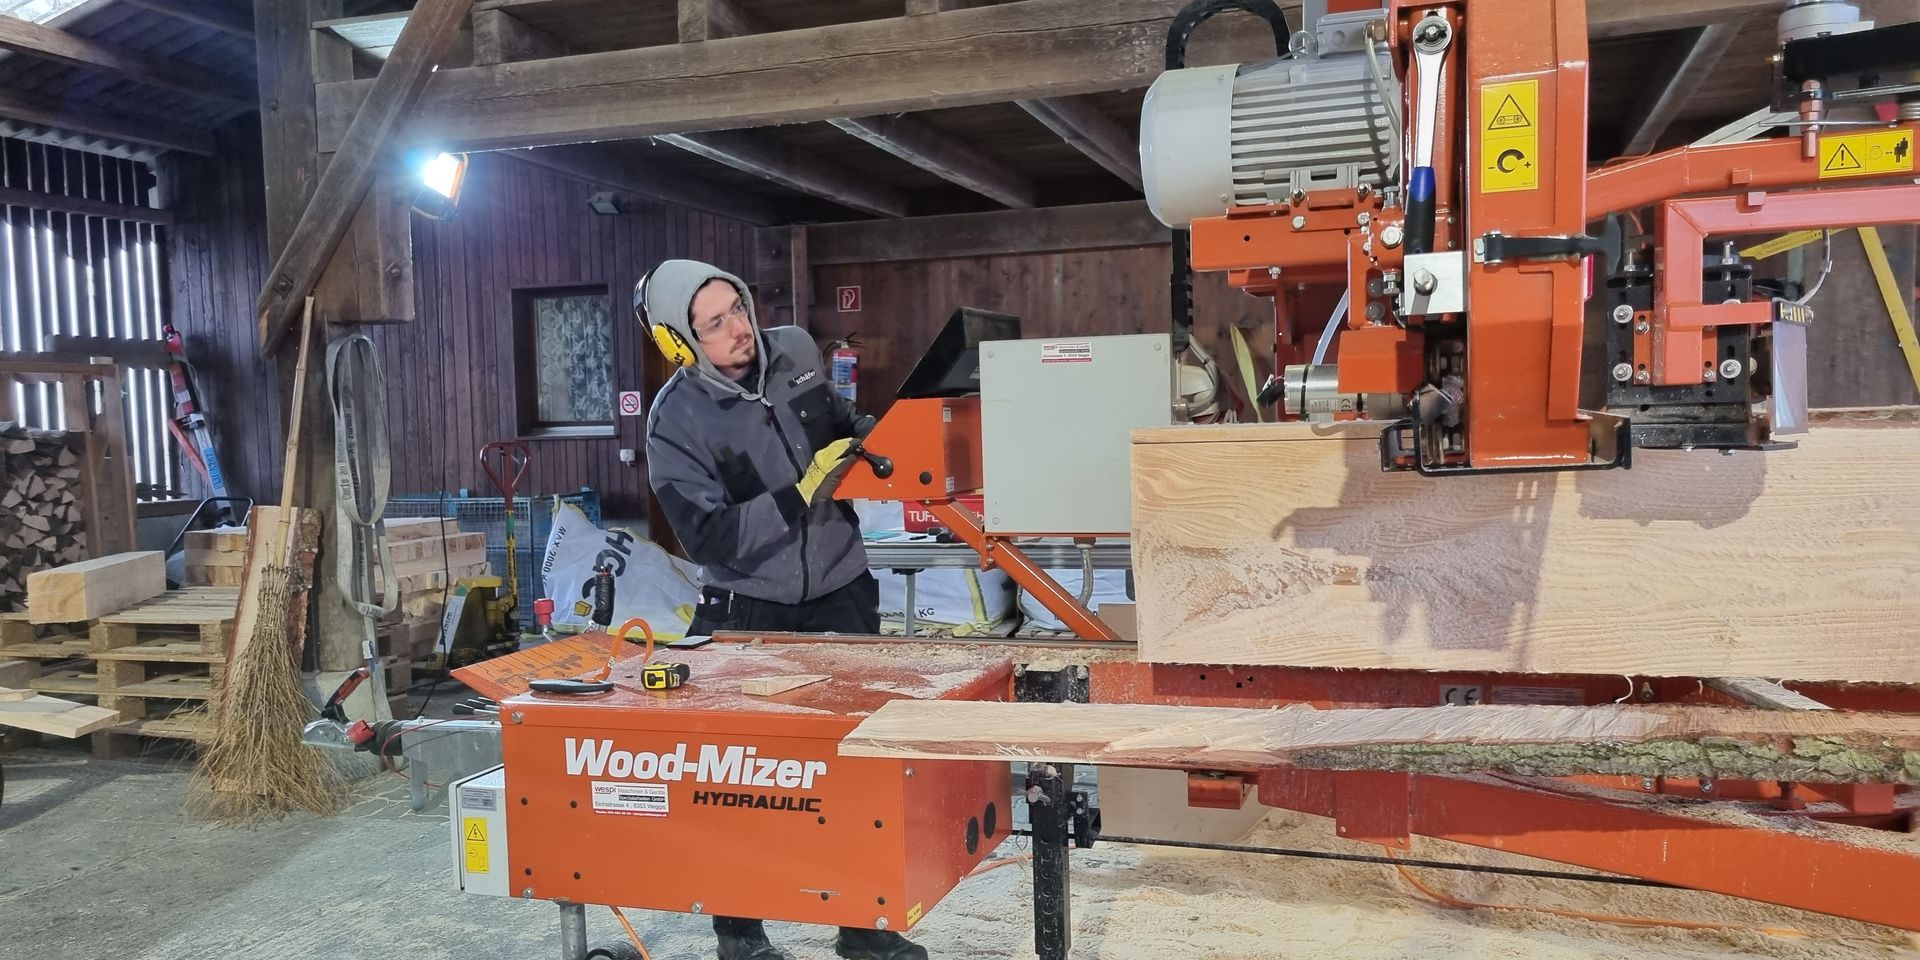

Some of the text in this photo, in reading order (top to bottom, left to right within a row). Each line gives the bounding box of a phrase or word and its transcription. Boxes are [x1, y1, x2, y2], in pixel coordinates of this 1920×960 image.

[554, 525, 567, 548] MAX
[543, 550, 557, 573] 2000
[919, 607, 935, 618] KG
[564, 737, 827, 789] Wood-Mizer
[693, 790, 822, 813] HYDRAULIC
